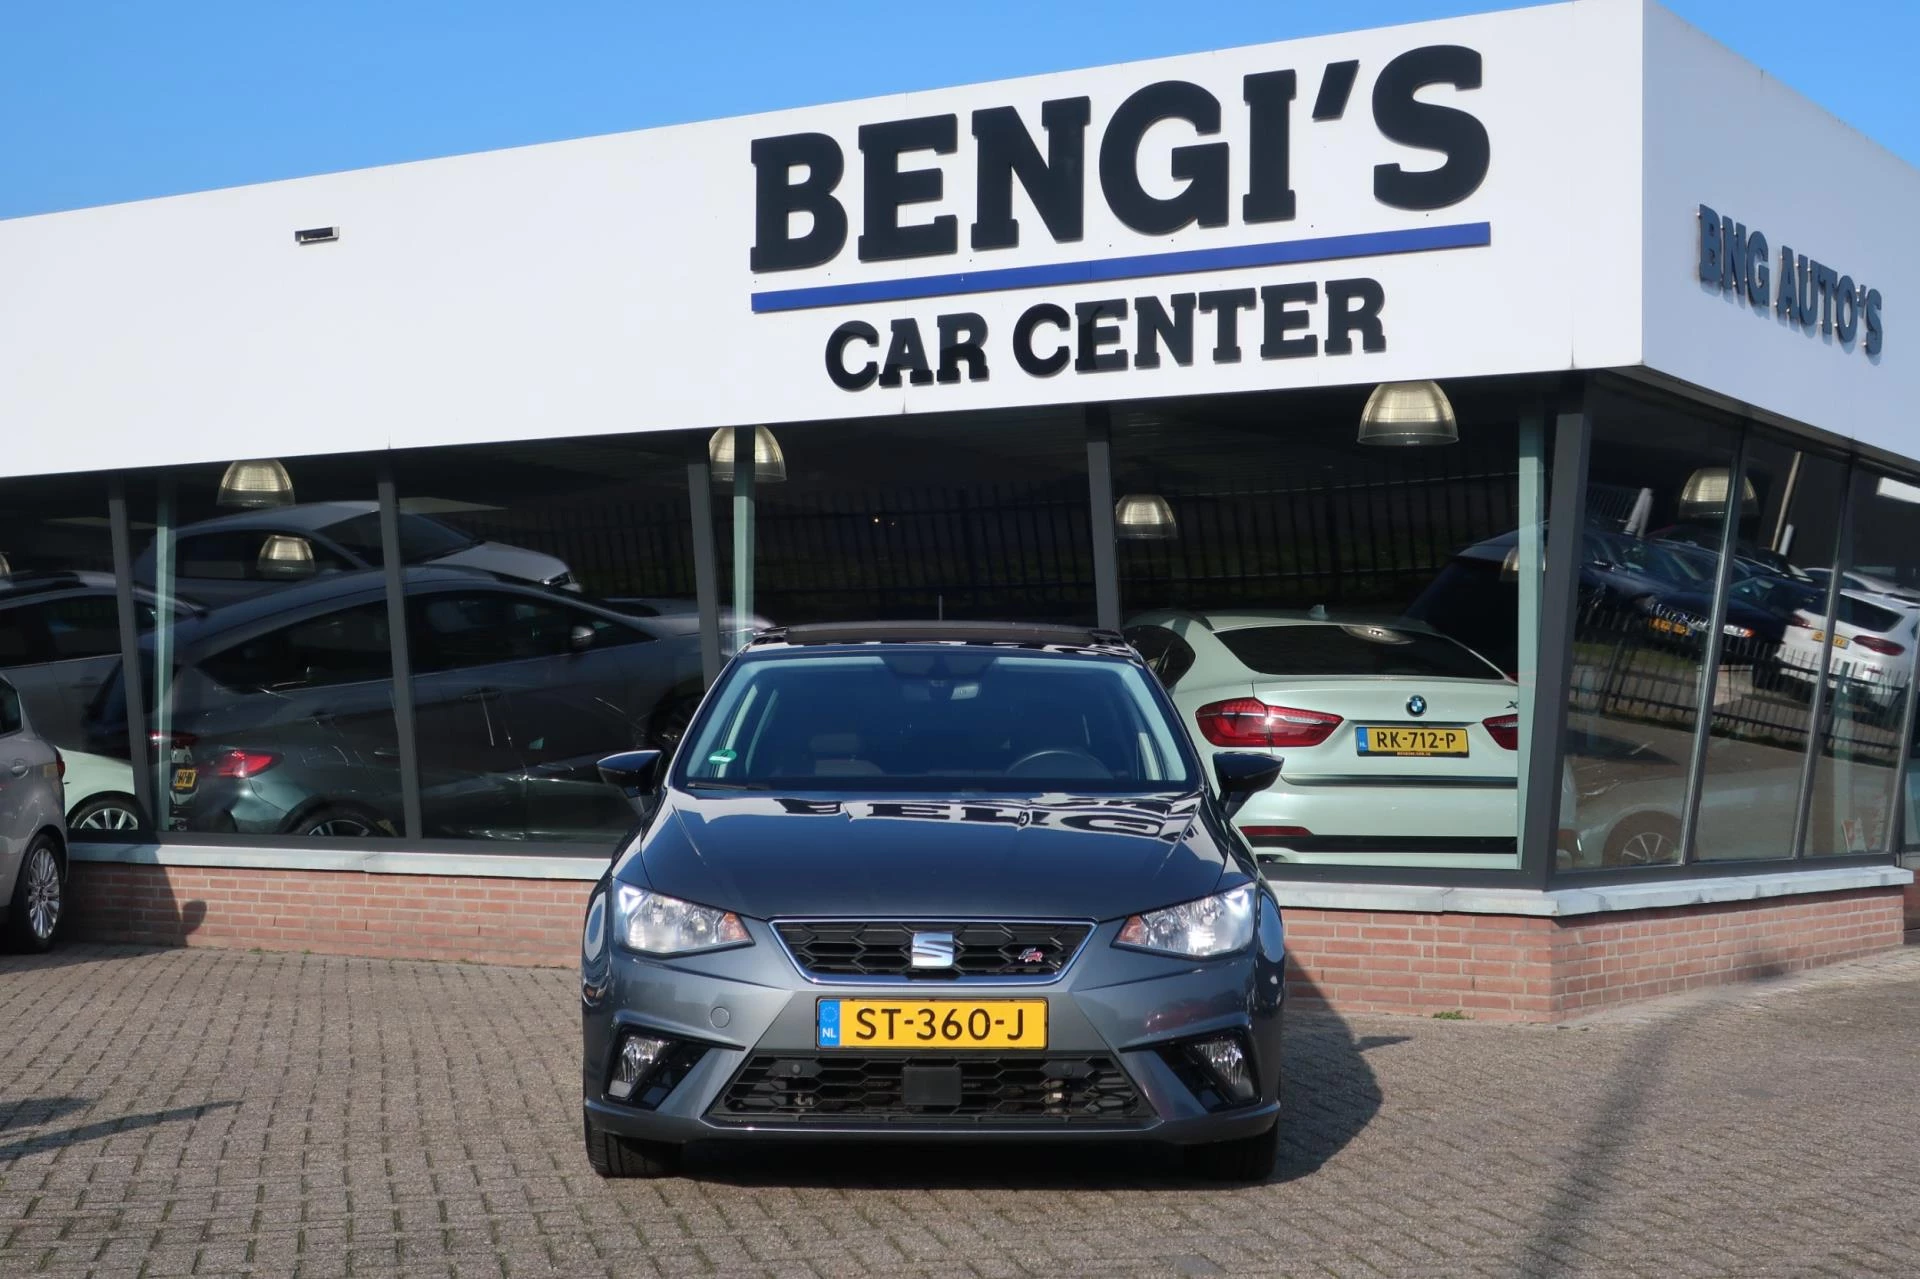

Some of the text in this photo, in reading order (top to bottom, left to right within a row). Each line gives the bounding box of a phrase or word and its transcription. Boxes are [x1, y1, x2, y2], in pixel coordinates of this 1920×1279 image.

[750, 44, 1491, 273] BENGI'S
[1698, 204, 1883, 356] BNG AUTO'S
[825, 277, 1387, 392] CAR CENTER
[1376, 731, 1457, 749] RK-712-P
[822, 1028, 837, 1038] NL
[856, 1008, 1024, 1041] ST-360-J
